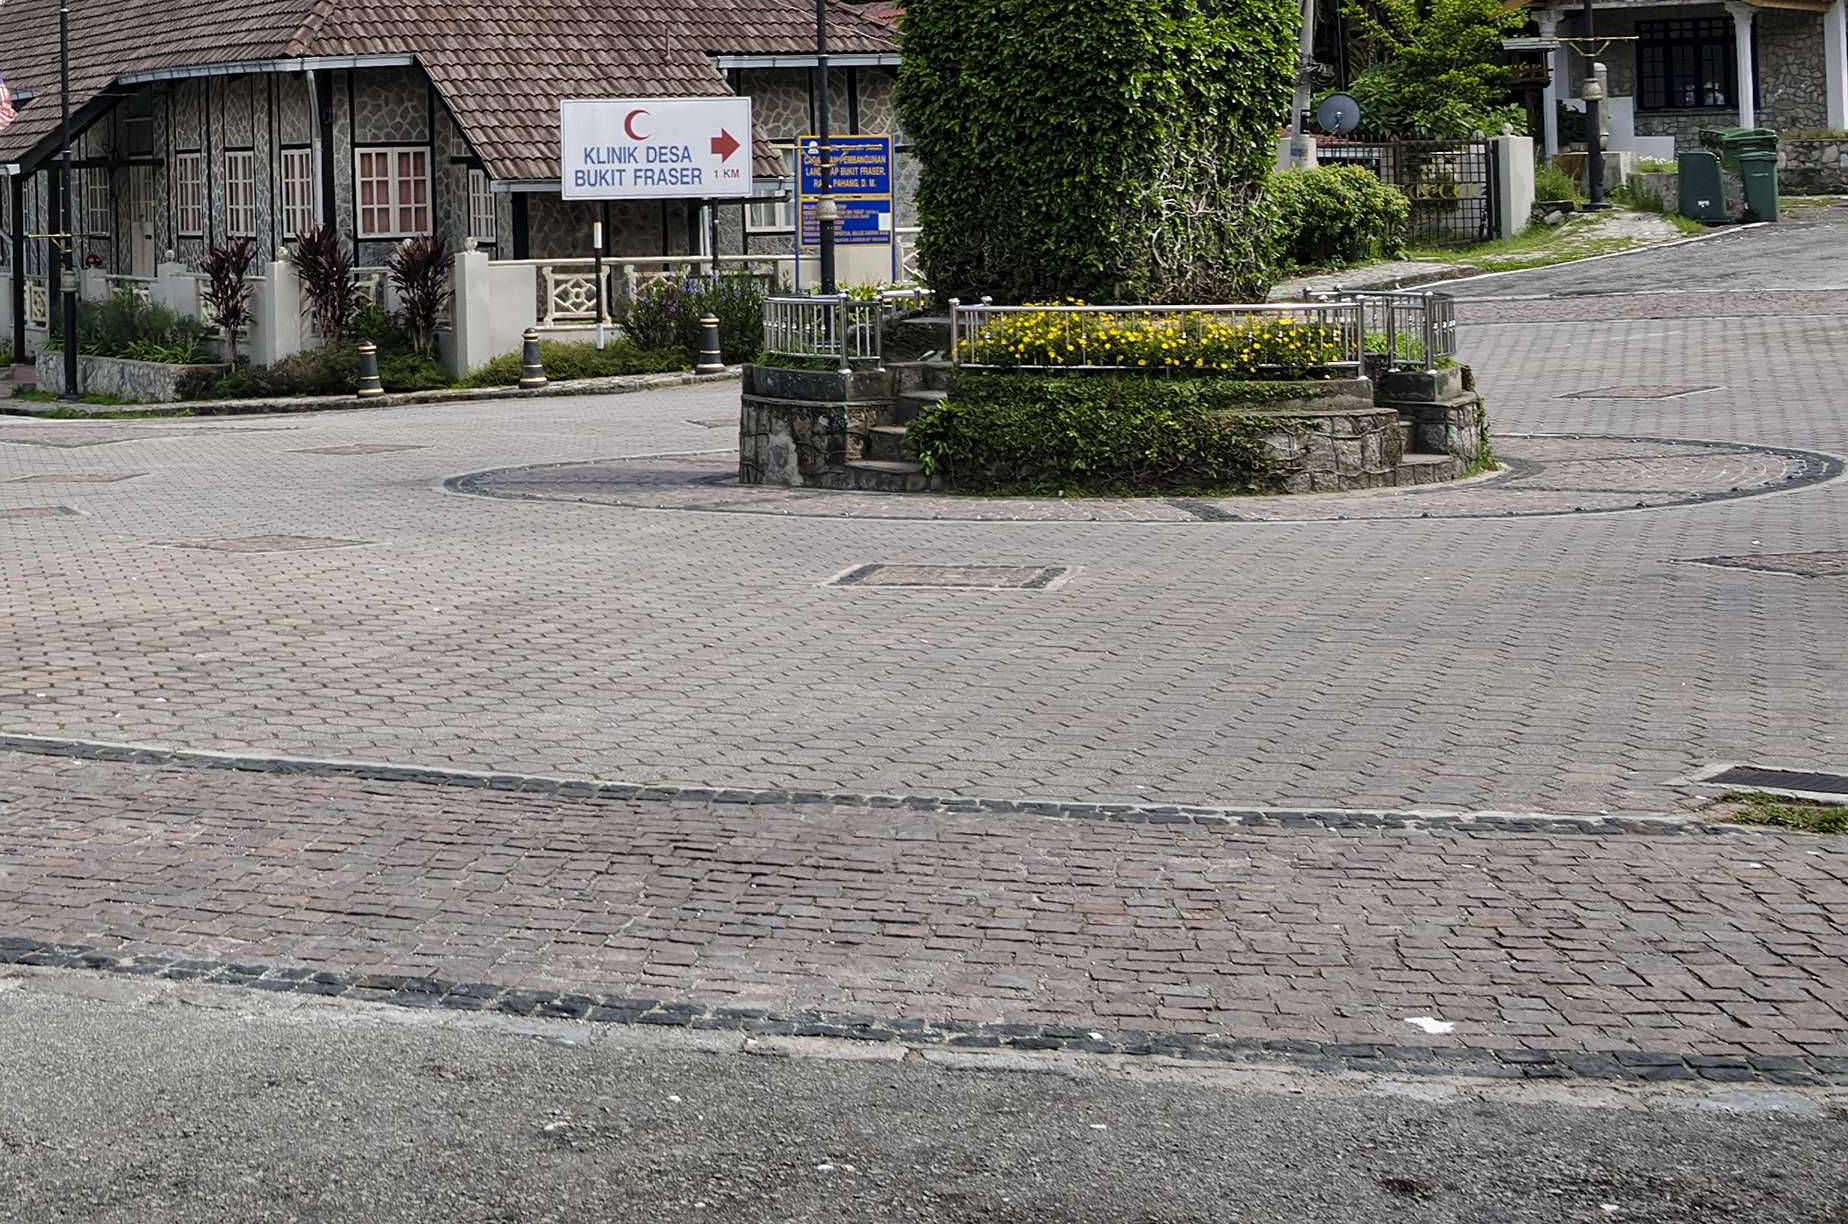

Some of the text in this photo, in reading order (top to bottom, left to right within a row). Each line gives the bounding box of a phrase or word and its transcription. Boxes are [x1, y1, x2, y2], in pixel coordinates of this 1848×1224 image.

[583, 145, 693, 165] KLINIK DESA
[574, 167, 703, 187] BUKIT FRASER
[713, 168, 740, 179] 1 KM
